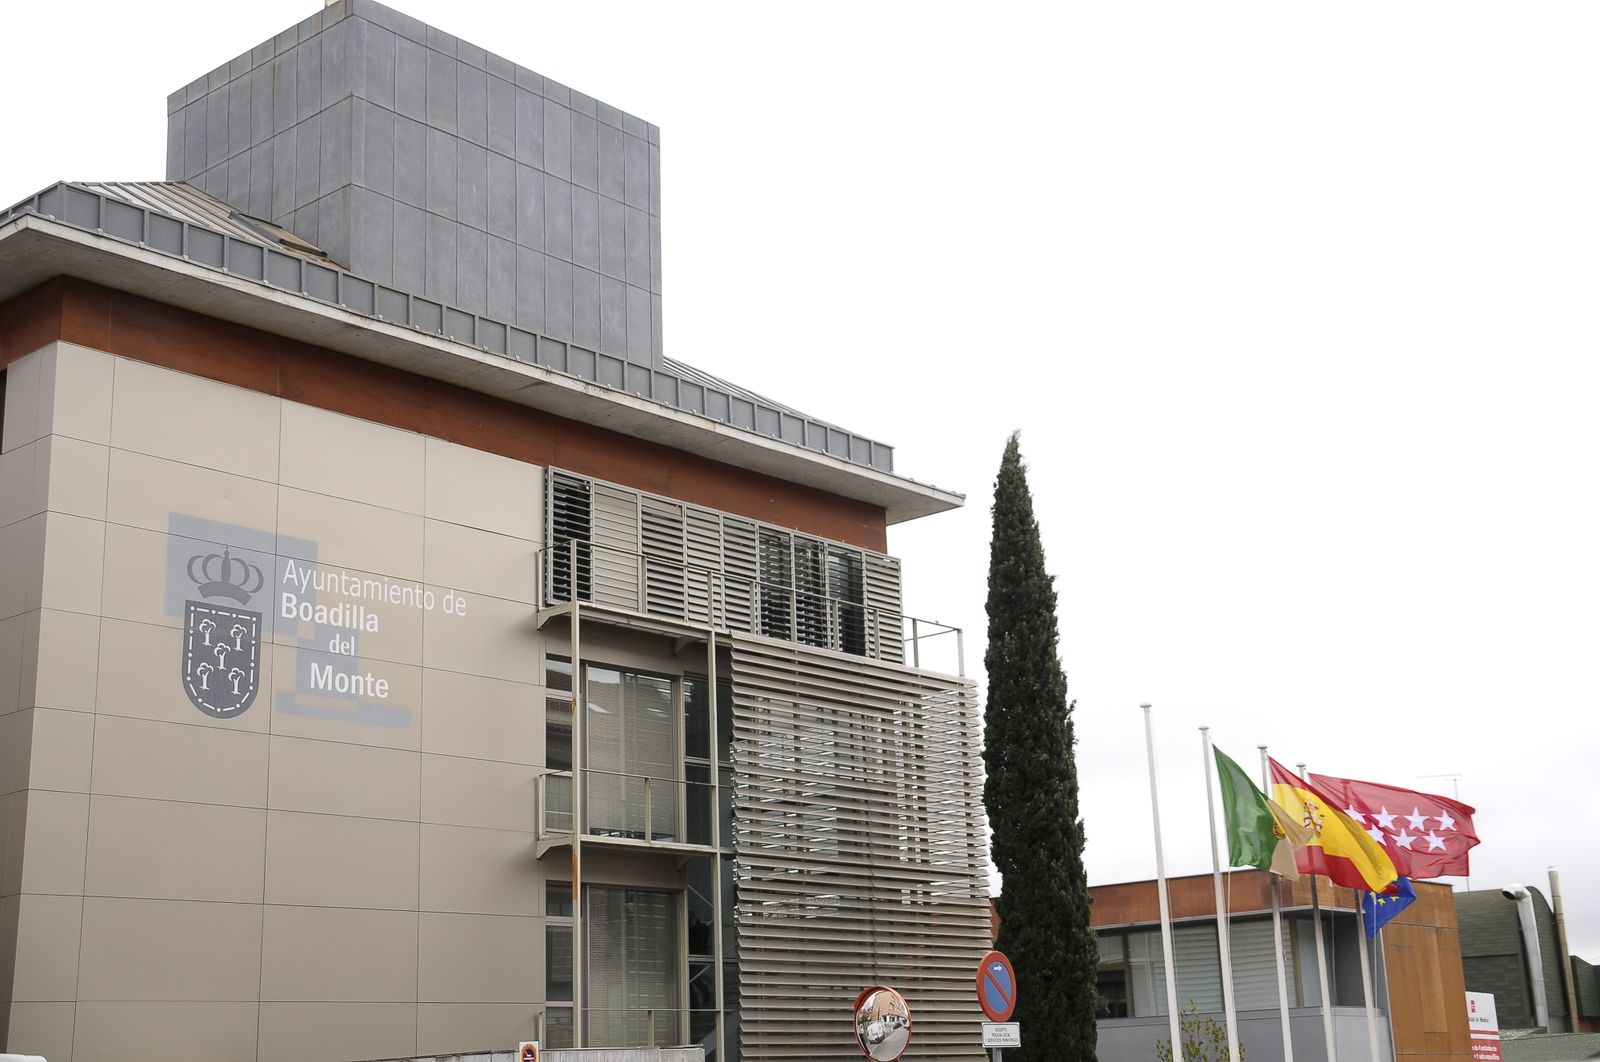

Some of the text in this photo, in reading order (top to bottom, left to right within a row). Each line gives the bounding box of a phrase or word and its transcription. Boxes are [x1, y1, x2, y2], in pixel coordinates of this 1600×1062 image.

[282, 559, 467, 616] Ayuntamiento de
[281, 592, 379, 632] Boadilla
[328, 633, 355, 656] del
[310, 662, 390, 698] Monte
